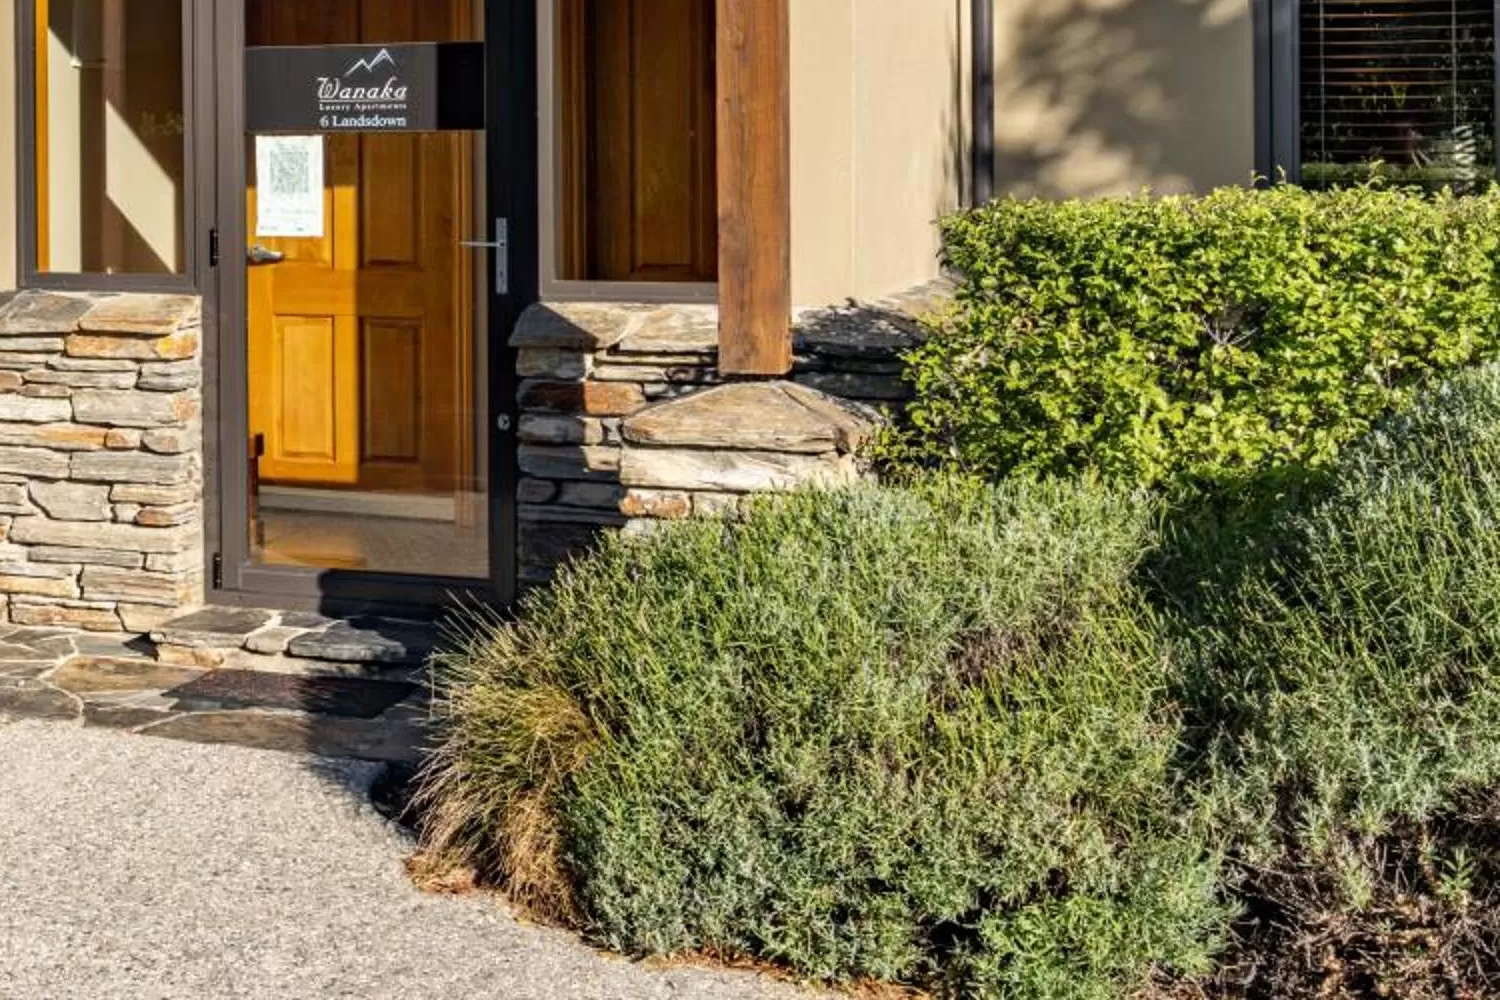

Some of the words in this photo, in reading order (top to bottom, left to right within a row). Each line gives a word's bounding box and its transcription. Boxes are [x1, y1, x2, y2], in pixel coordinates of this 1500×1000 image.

[316, 76, 408, 100] Wanaka
[319, 115, 329, 128] 6
[331, 114, 407, 128] Landsdown
